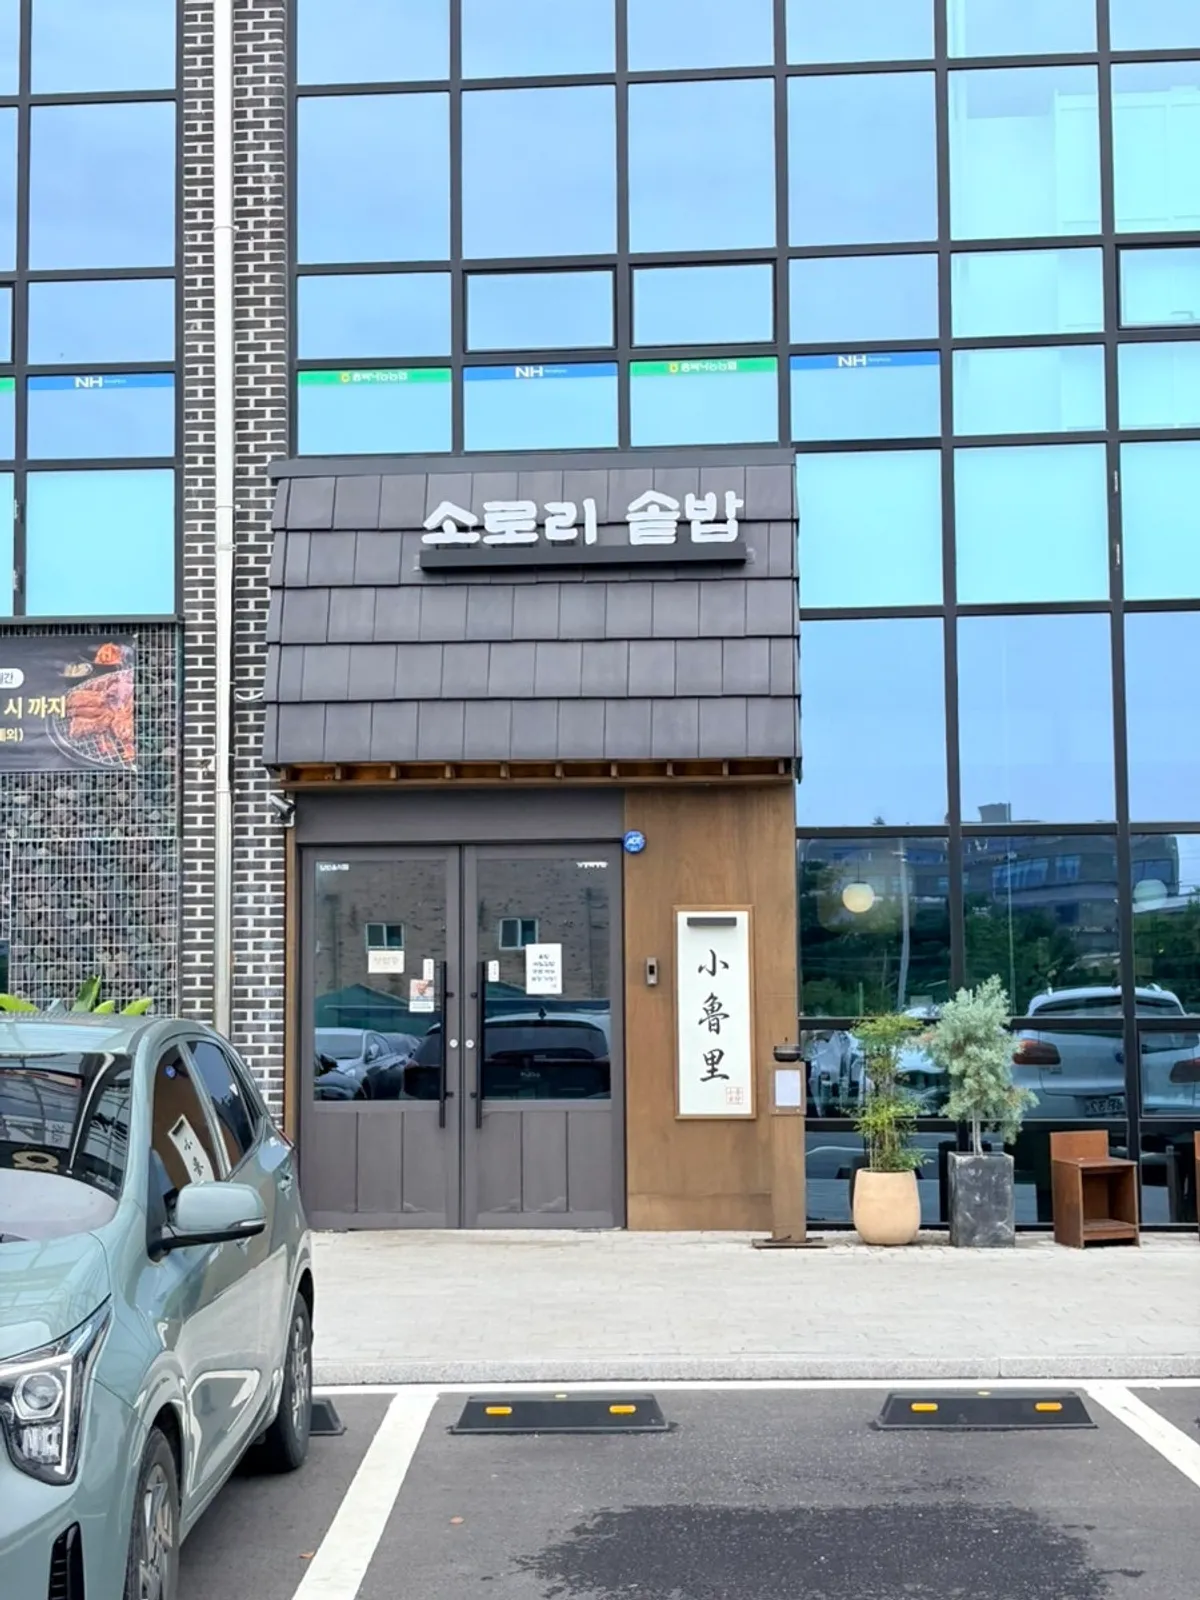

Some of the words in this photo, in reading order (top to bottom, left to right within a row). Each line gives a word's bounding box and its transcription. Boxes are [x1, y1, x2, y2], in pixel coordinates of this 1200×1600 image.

[838, 355, 866, 367] NH
[515, 366, 543, 378] NH
[75, 376, 103, 388] NH
[421, 497, 598, 545] 소로리
[625, 489, 745, 545] 솥밥
[4, 696, 23, 719] 시
[27, 695, 66, 719] 까지
[697, 949, 730, 1083] 小魯里
